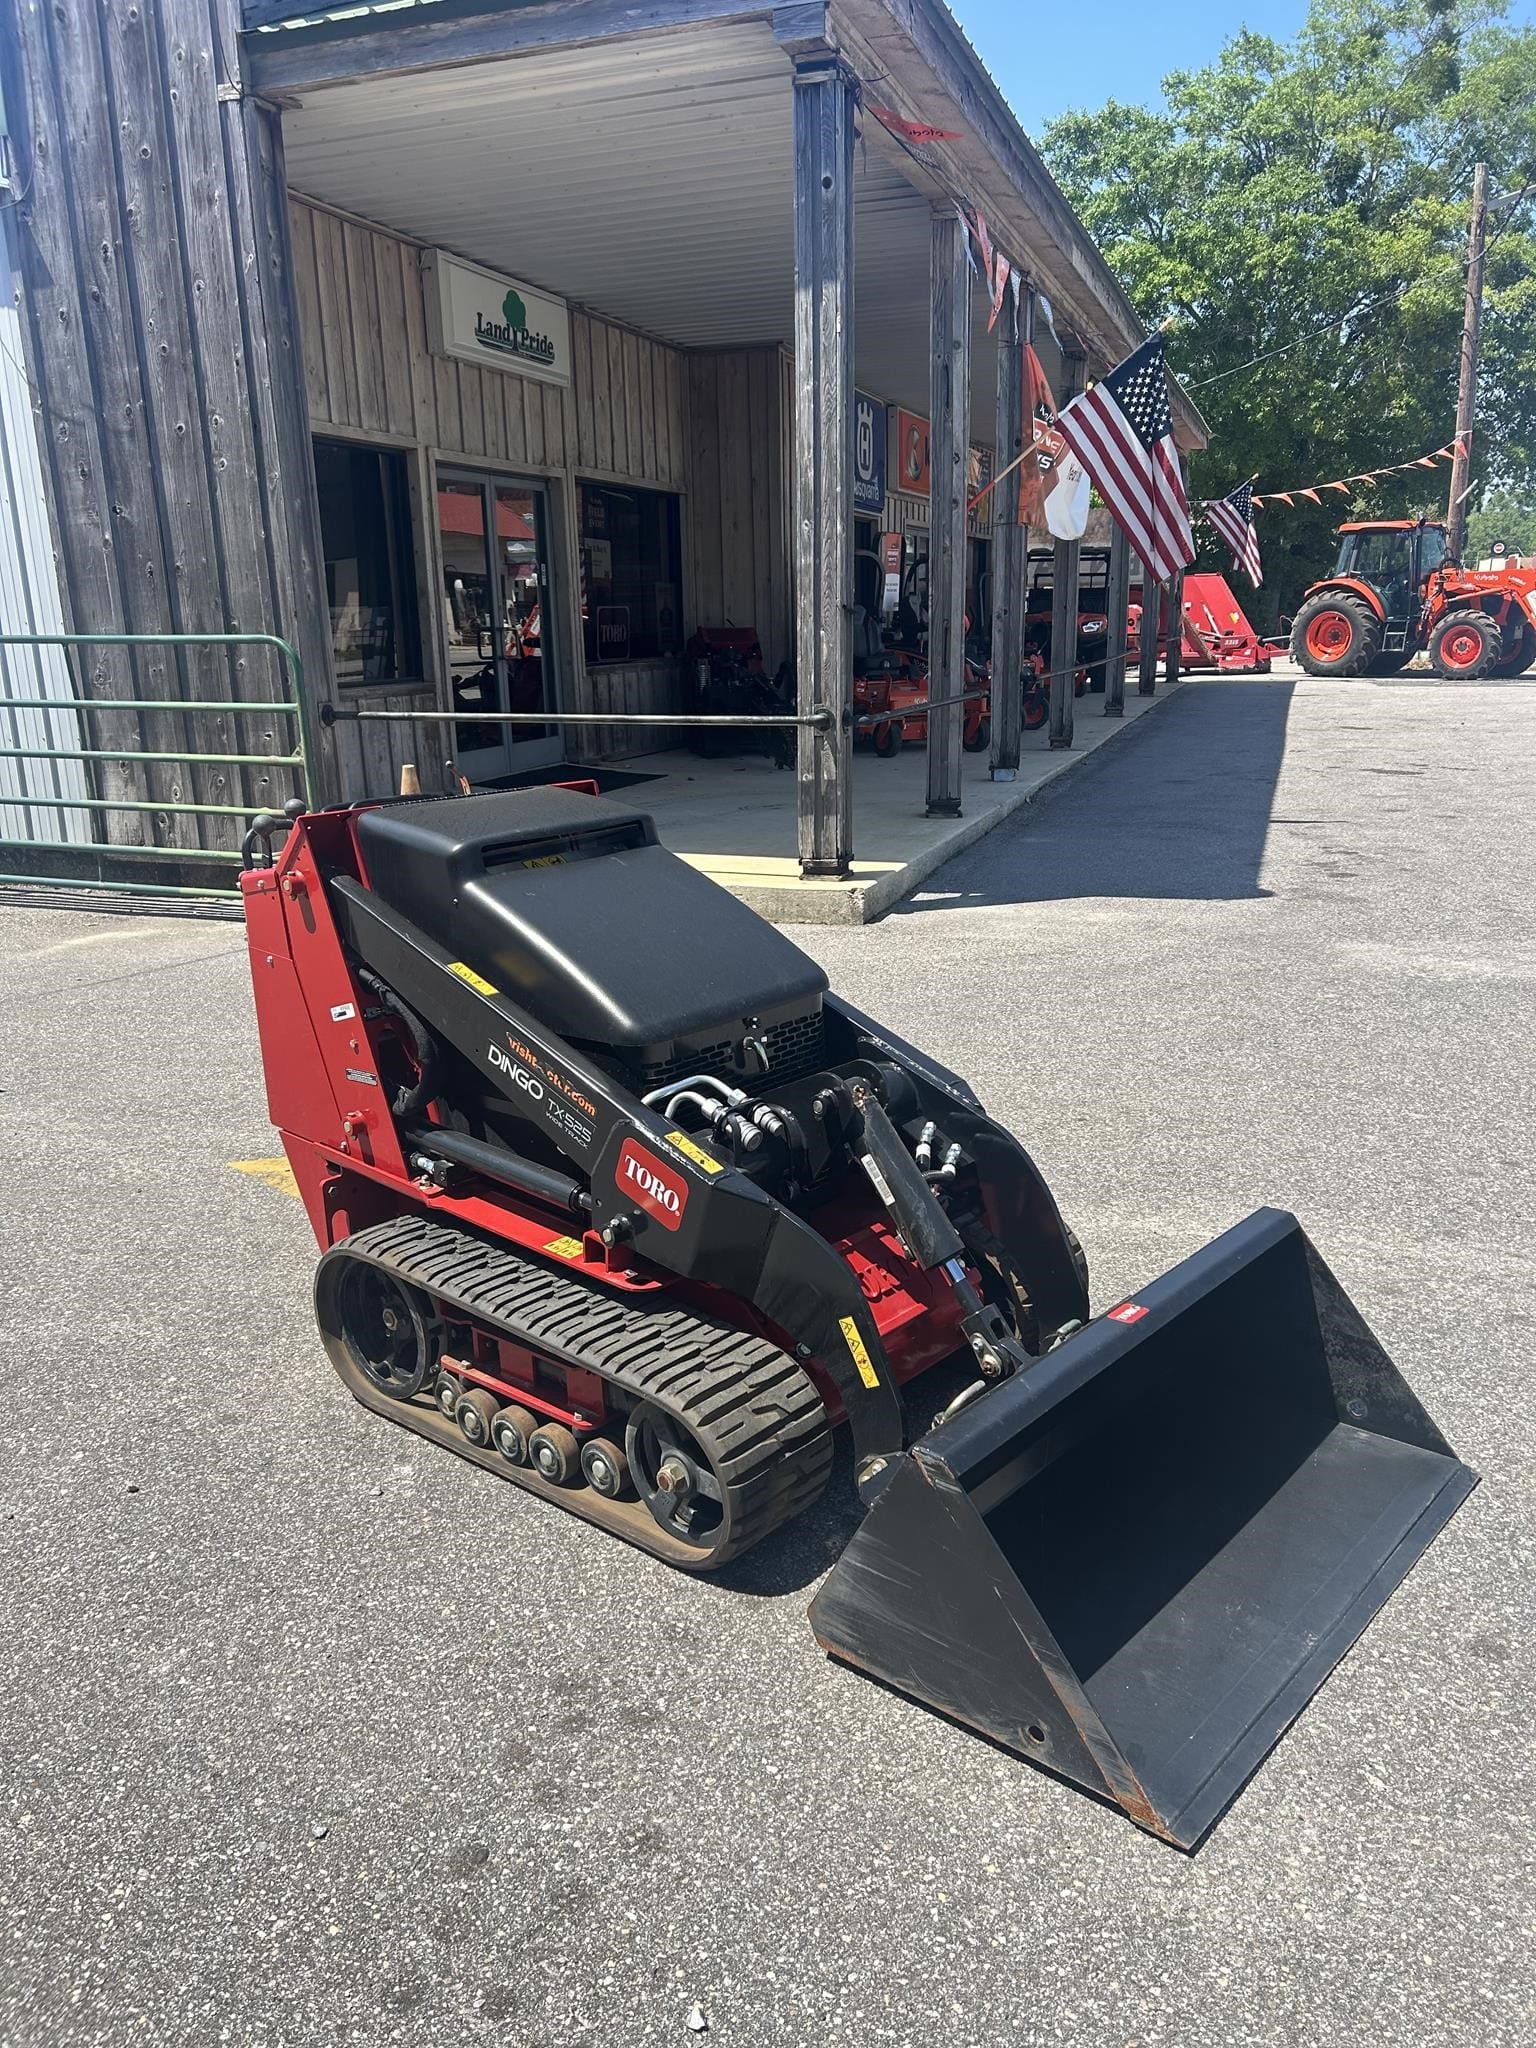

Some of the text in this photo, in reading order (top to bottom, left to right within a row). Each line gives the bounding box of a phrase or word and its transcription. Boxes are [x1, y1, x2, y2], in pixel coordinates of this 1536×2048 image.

[476, 311, 554, 356] Land Pride
[854, 480, 880, 501] usqvarna
[600, 624, 627, 643] TORO
[488, 1044, 544, 1100] DINGO
[545, 1111, 590, 1150] WIDE TRACK
[624, 1154, 680, 1213] TORO
